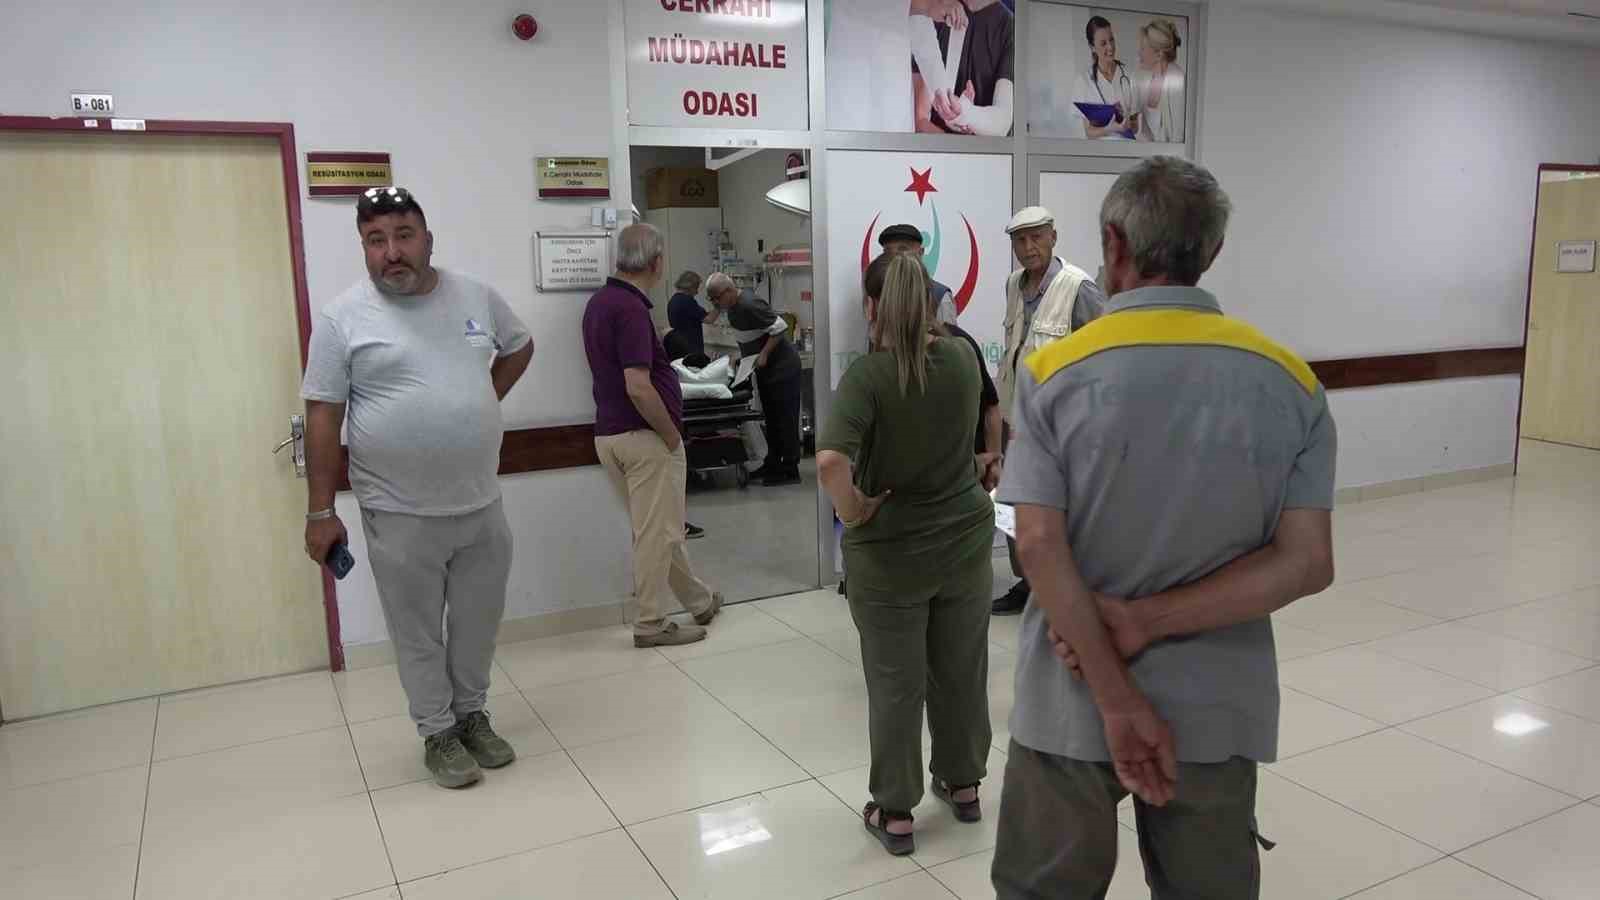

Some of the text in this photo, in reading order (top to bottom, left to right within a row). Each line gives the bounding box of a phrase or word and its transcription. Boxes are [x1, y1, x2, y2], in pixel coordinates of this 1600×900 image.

[648, 33, 786, 69] MÜDAHALE
[74, 98, 82, 110] B
[91, 98, 110, 111] 081
[683, 90, 758, 117] ODASI
